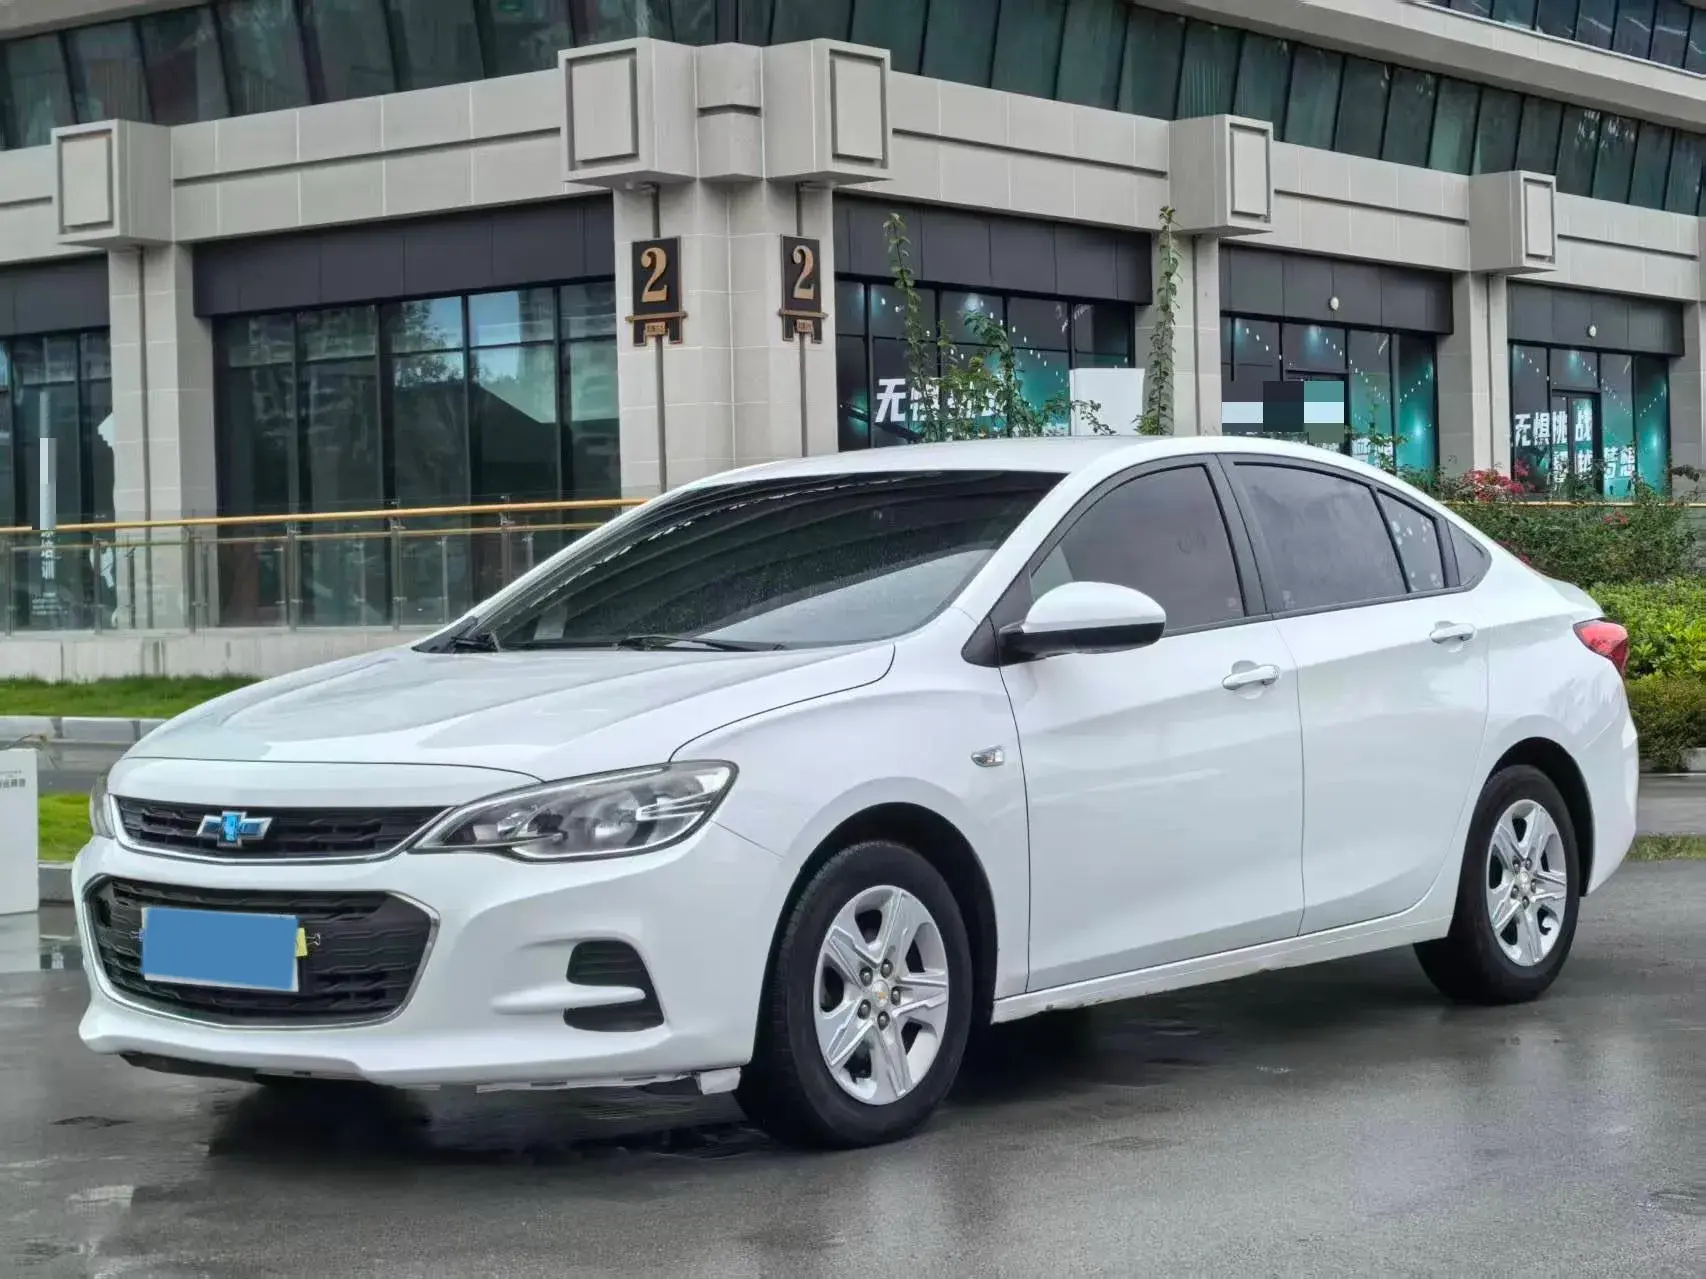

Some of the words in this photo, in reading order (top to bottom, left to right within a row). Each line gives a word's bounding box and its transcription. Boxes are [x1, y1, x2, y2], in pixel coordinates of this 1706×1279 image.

[641, 247, 668, 303] 2
[792, 245, 815, 300] 2
[1514, 408, 1593, 447] 无惧挑战
